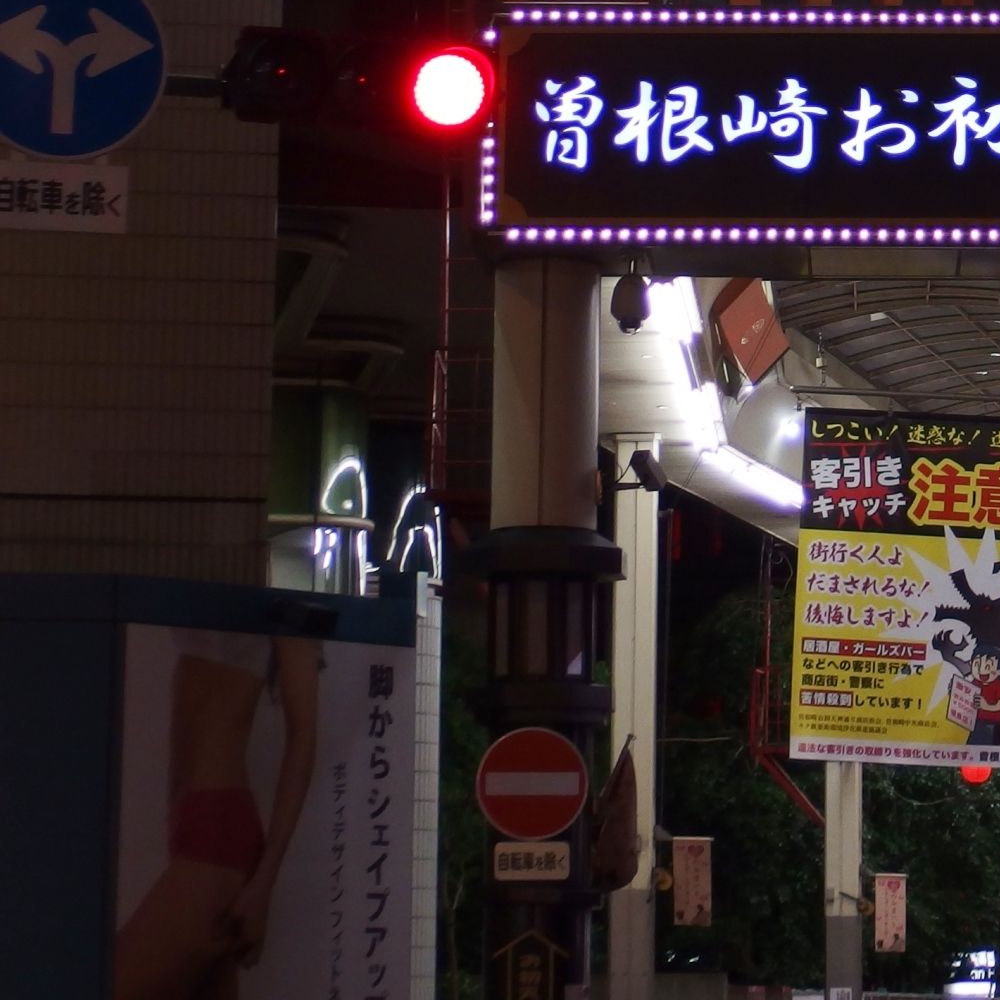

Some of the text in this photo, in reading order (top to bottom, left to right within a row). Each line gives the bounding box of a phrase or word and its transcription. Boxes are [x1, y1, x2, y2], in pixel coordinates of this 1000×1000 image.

[0, 177, 122, 217] 自転車を除く
[810, 456, 904, 489] 客引き
[812, 492, 907, 519] キャッチ
[808, 541, 904, 566] 街行く人よ
[362, 664, 394, 1000] 脚からシェイプアッ
